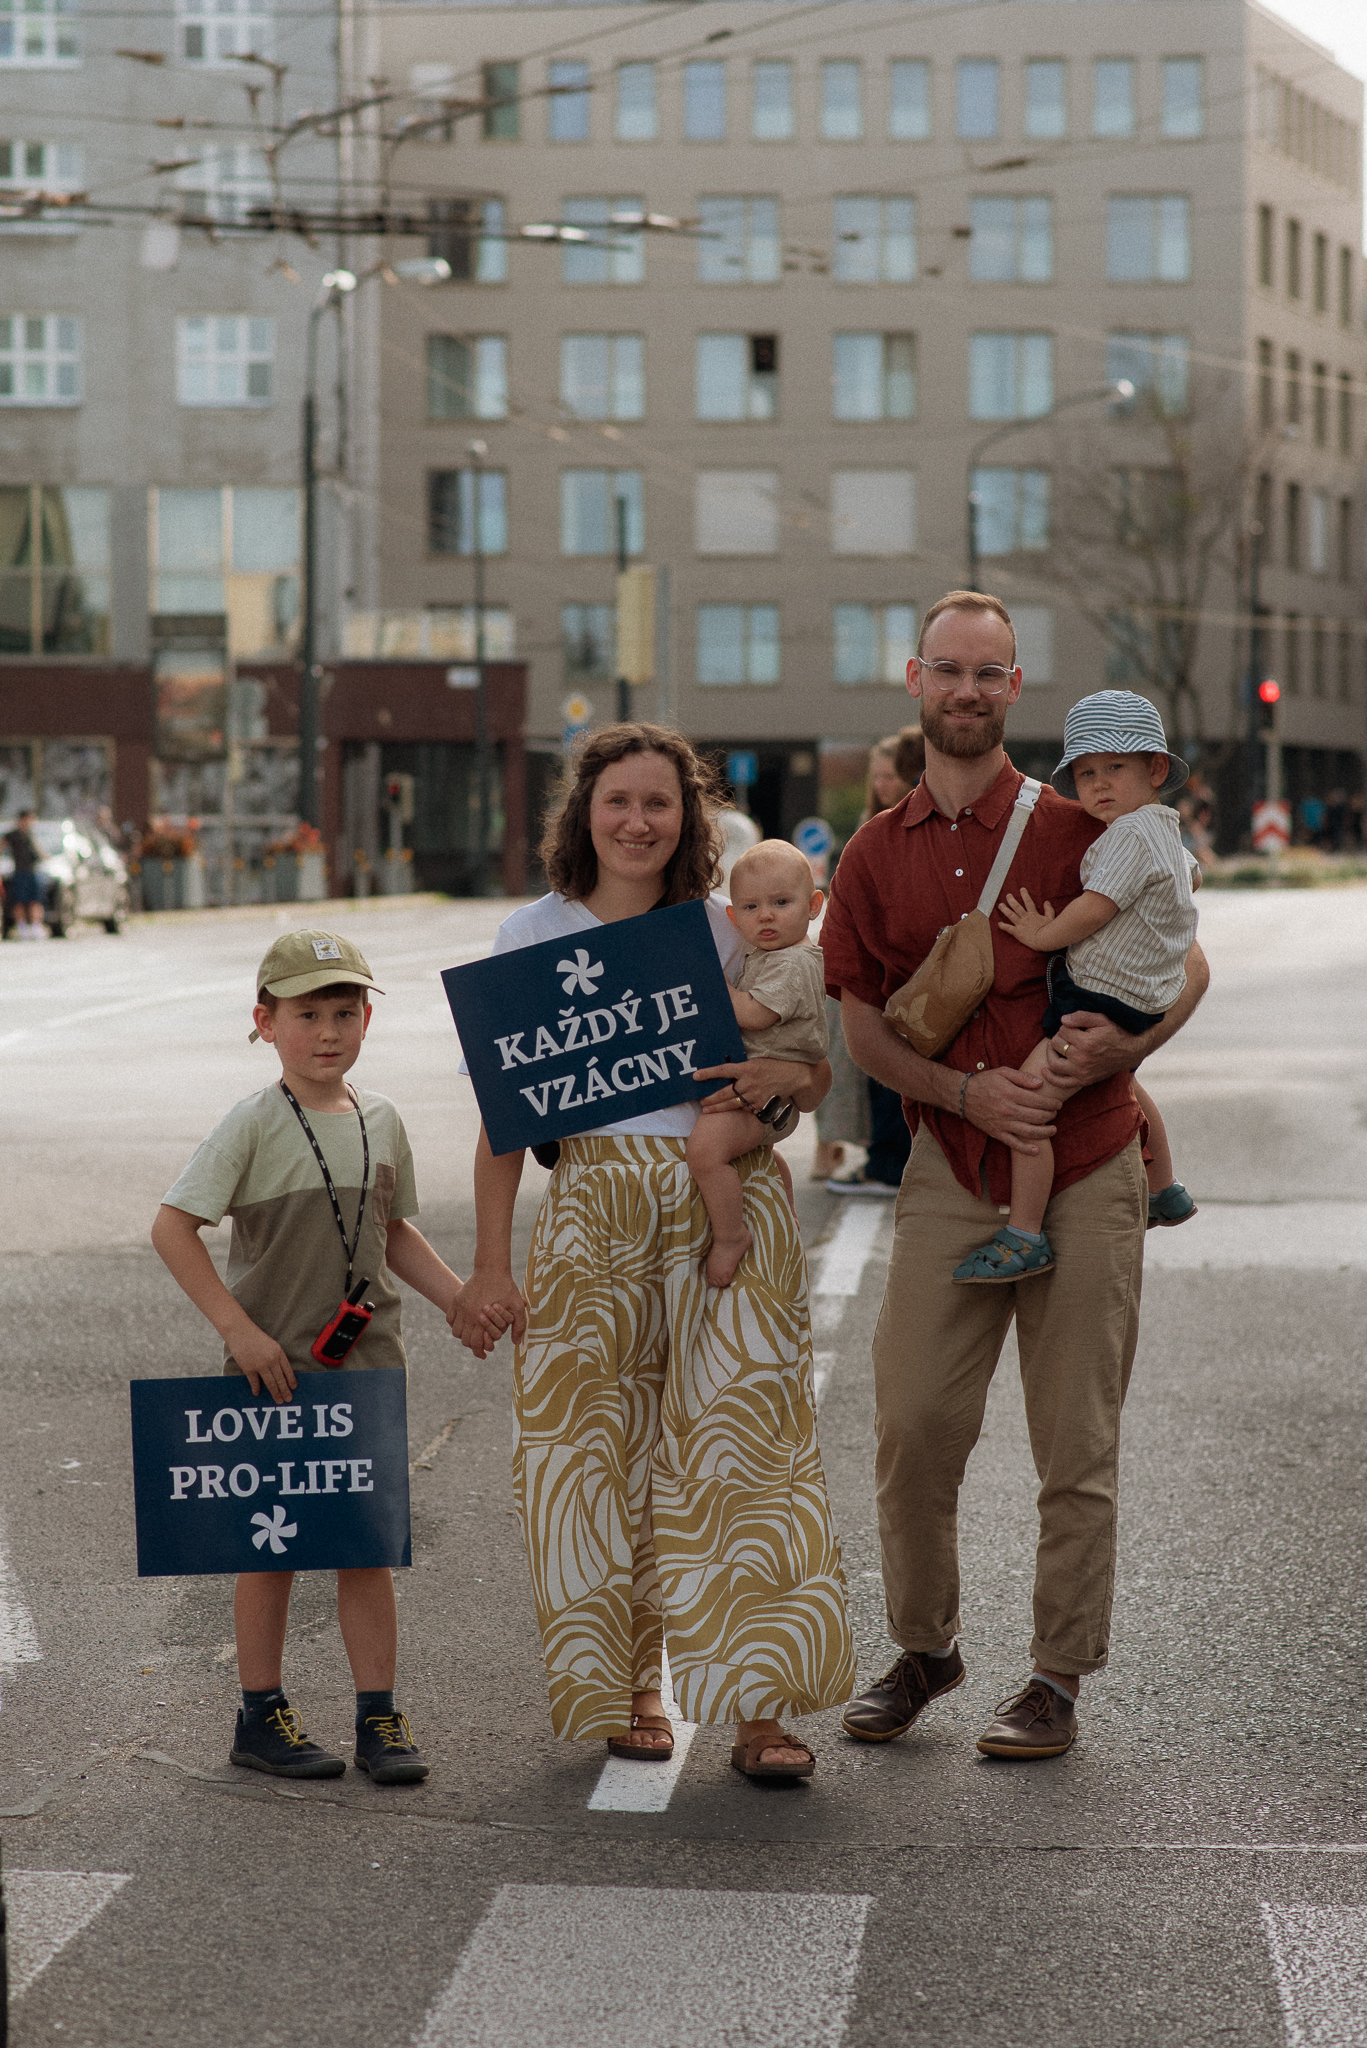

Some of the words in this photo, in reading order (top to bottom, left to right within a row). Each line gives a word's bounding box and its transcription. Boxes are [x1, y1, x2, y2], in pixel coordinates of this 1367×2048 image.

[494, 988, 644, 1071] KAŽDÝ
[650, 984, 699, 1035] JE
[519, 1039, 698, 1117] VZÁCNY
[184, 1405, 304, 1443] LOVE
[312, 1403, 354, 1438] IS
[168, 1458, 374, 1500] PRO-LIFE
